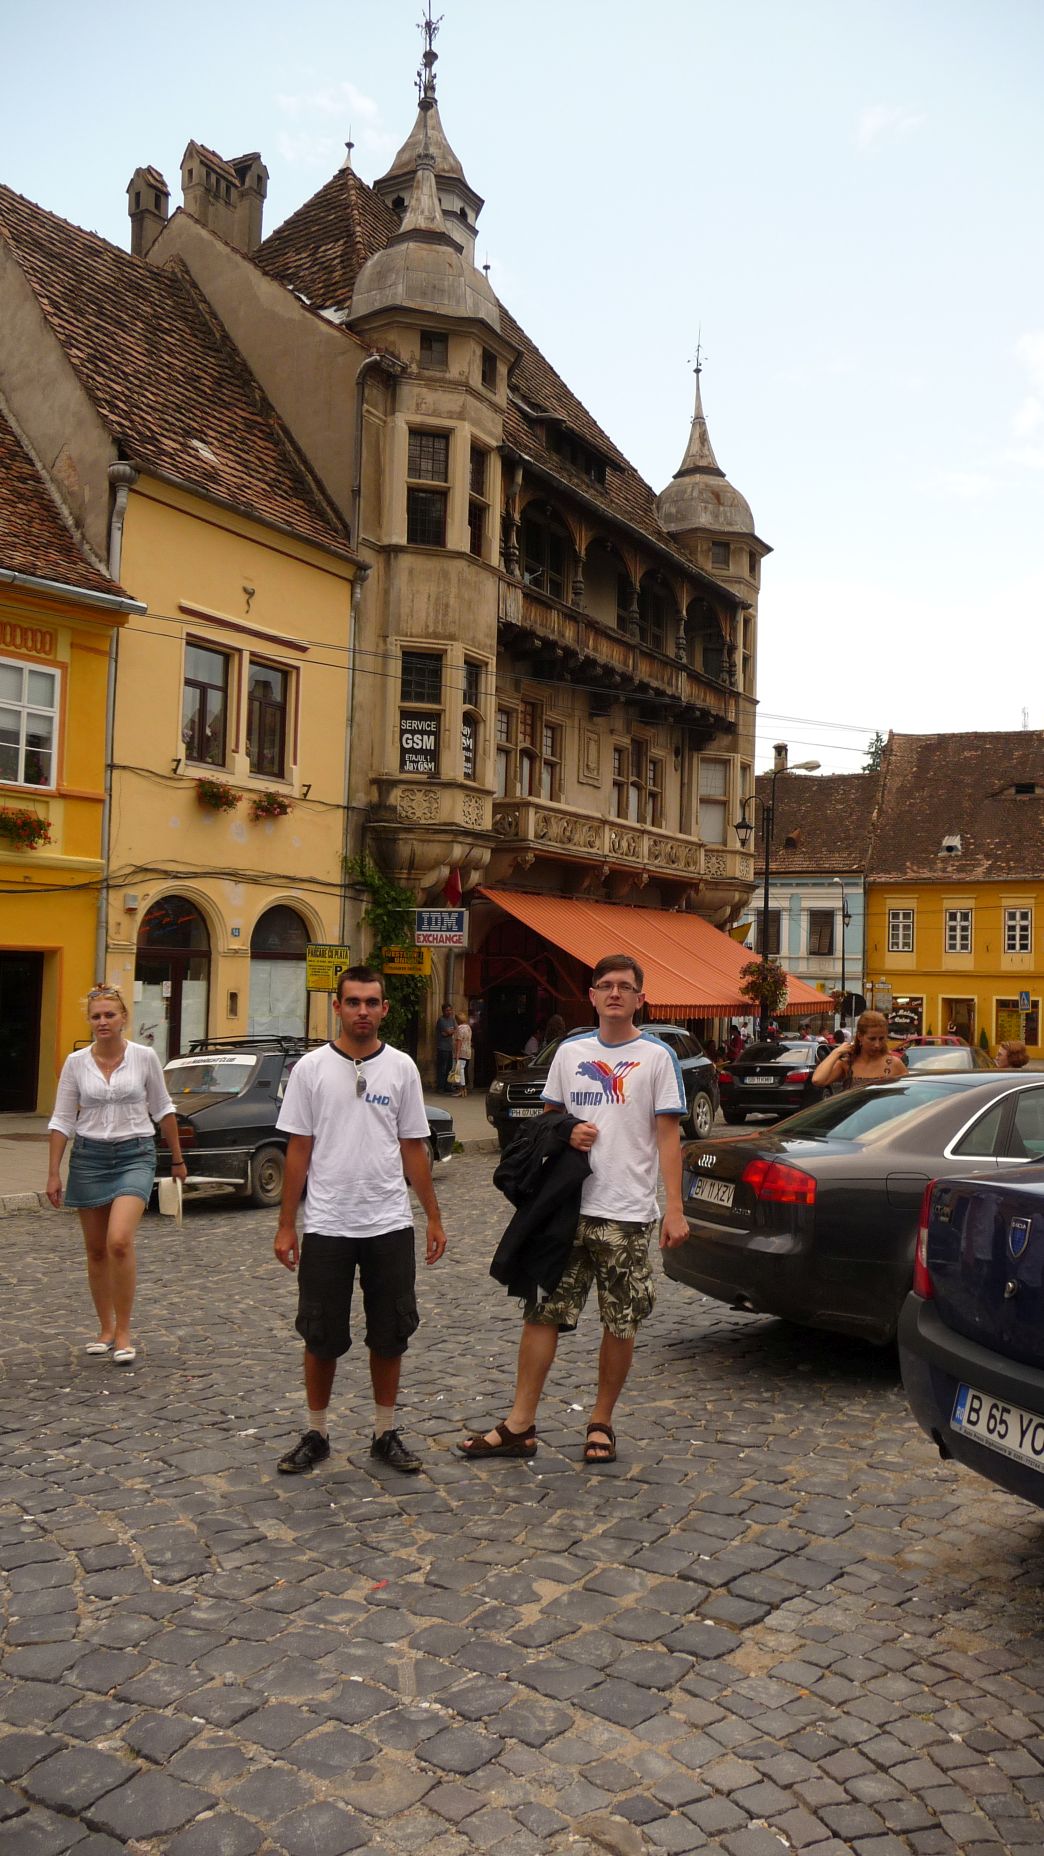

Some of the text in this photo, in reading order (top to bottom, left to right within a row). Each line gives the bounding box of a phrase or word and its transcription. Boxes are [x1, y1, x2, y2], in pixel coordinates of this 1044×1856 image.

[401, 720, 437, 731] SERVICE
[402, 734, 435, 750] GSM
[405, 753, 426, 762] ETAJUL
[416, 933, 464, 944] EXCHANGE
[334, 965, 343, 976] P
[365, 1093, 390, 1106] LHD
[570, 1092, 604, 1106] PUMA
[966, 1394, 983, 1427] B
[986, 1402, 1011, 1440] 65
